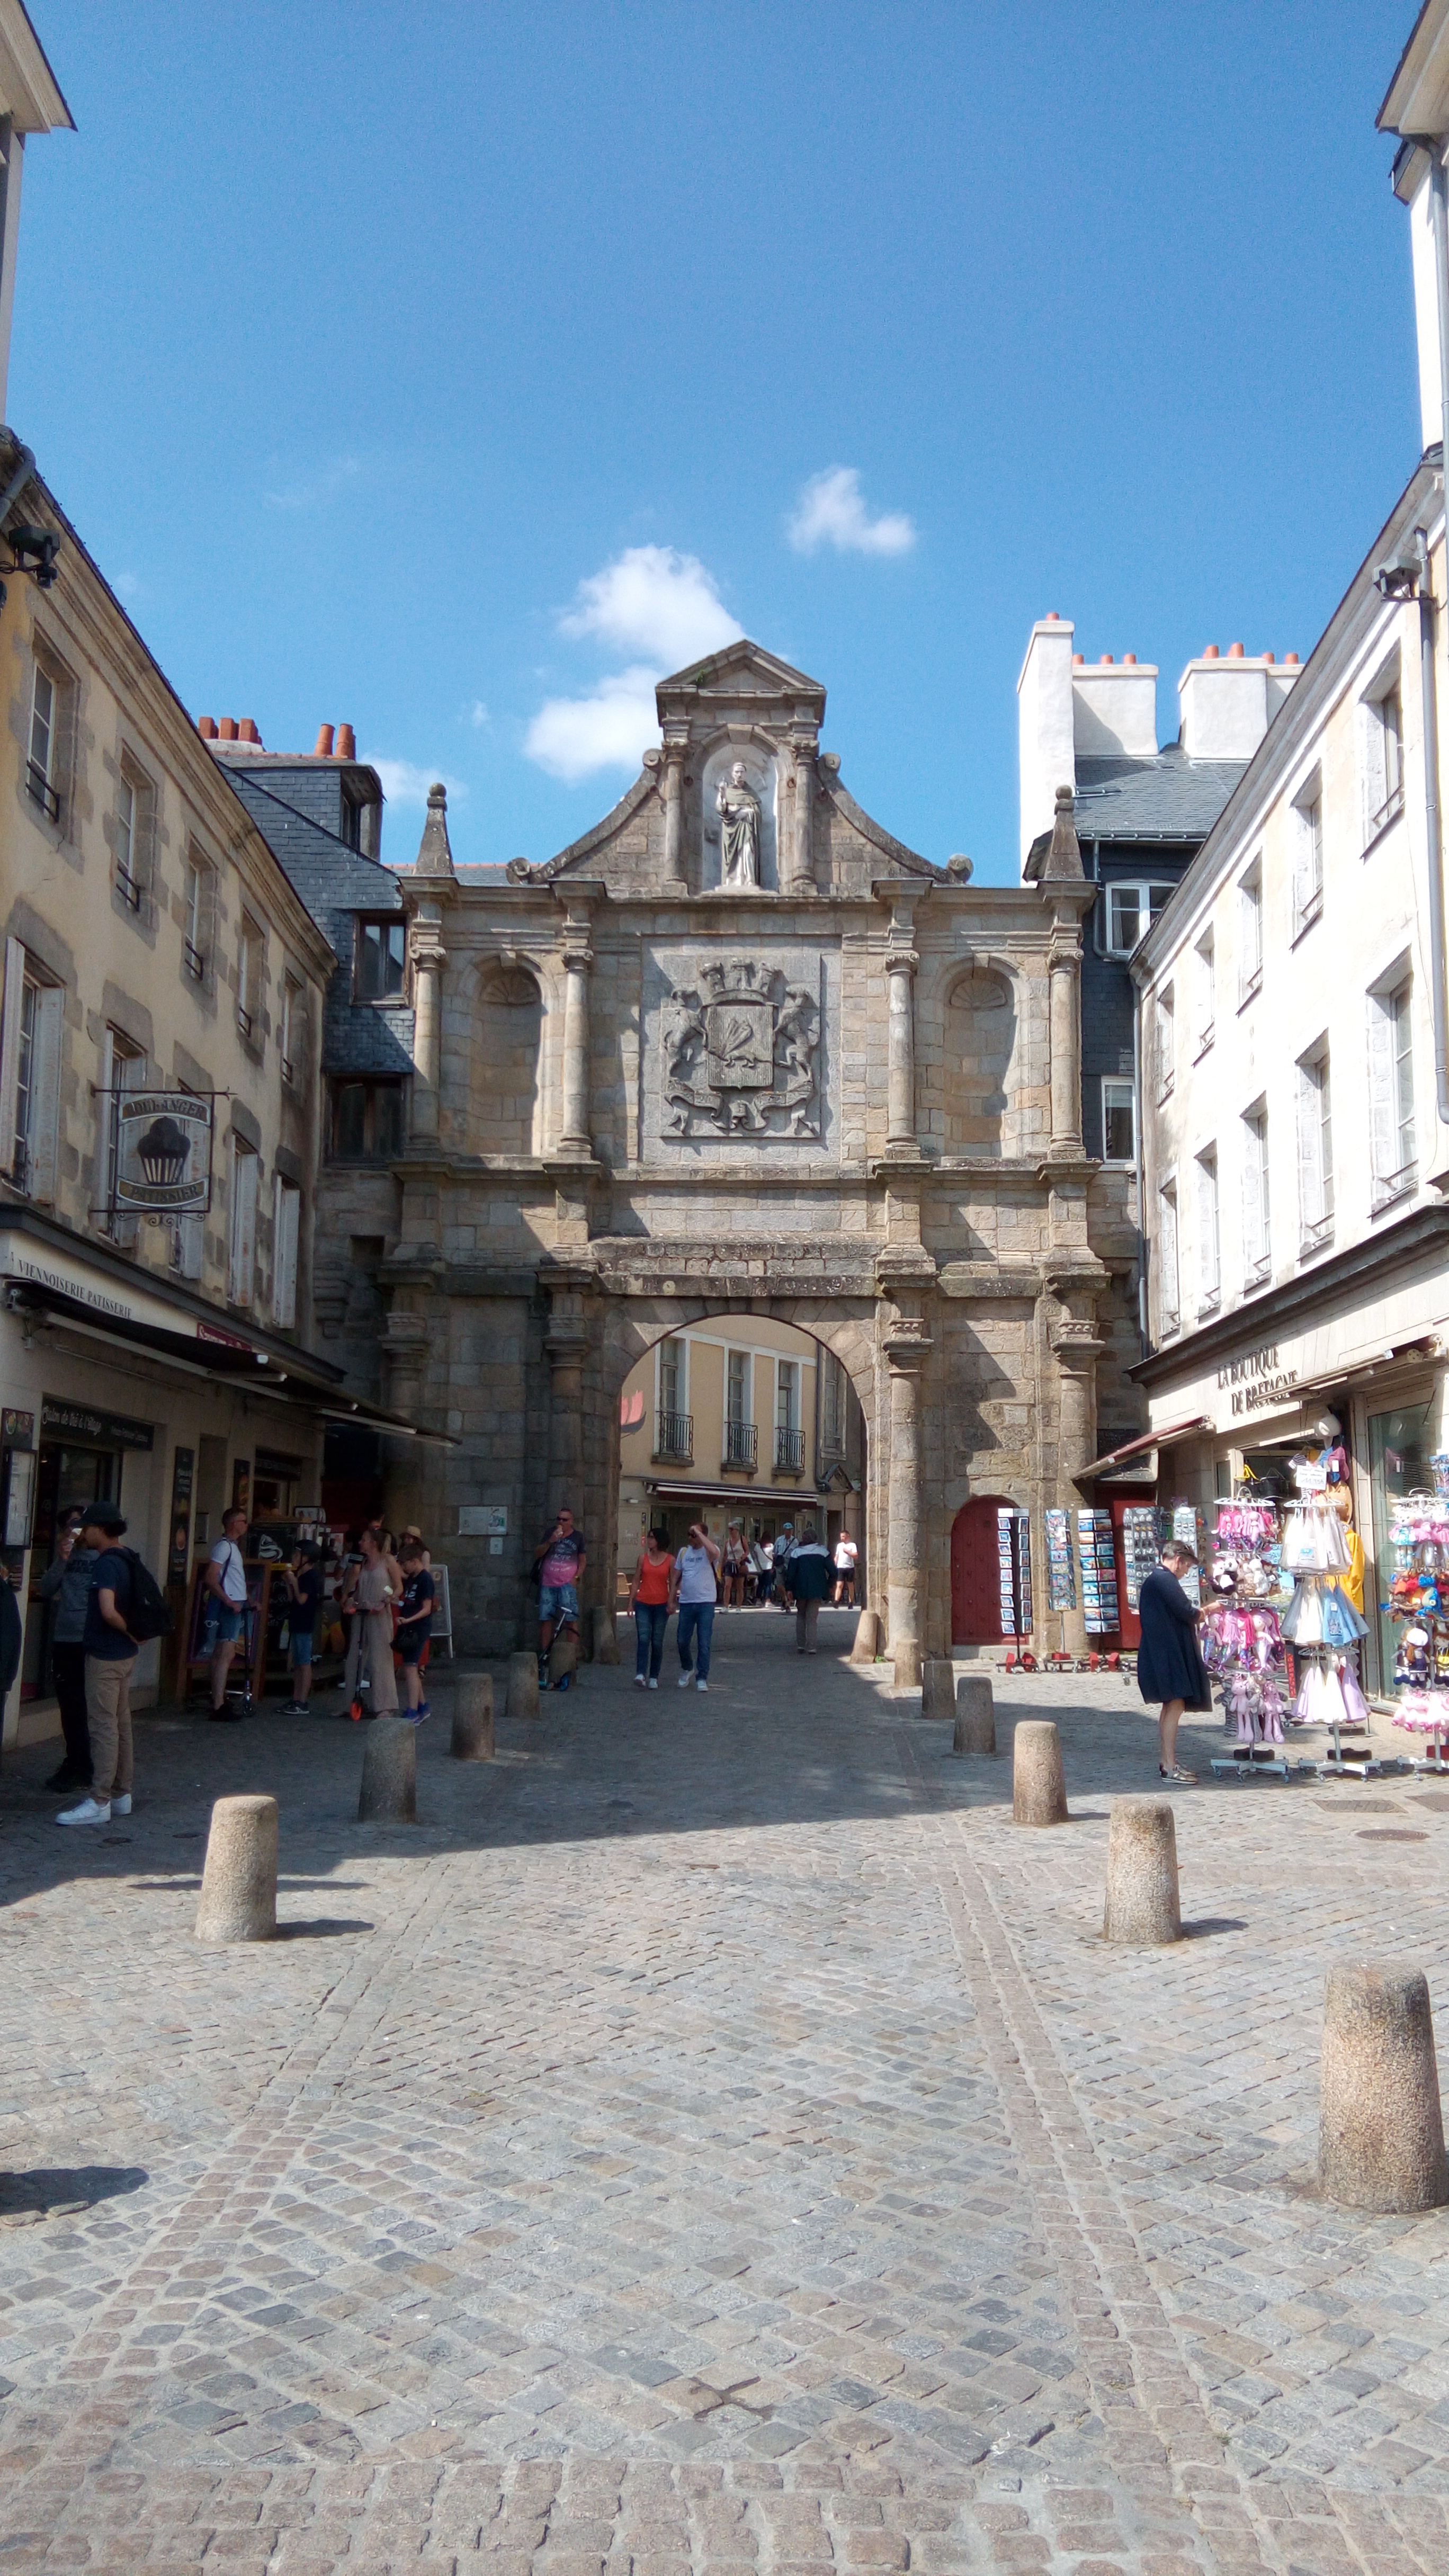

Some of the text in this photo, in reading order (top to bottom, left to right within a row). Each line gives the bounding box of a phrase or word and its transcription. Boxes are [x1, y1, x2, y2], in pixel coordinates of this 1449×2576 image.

[18, 1258, 132, 1319] VIENNOISERIE PATISSERIE
[1218, 1343, 1280, 1390] LA BOUTIQUE
[1231, 1390, 1244, 1416] DE
